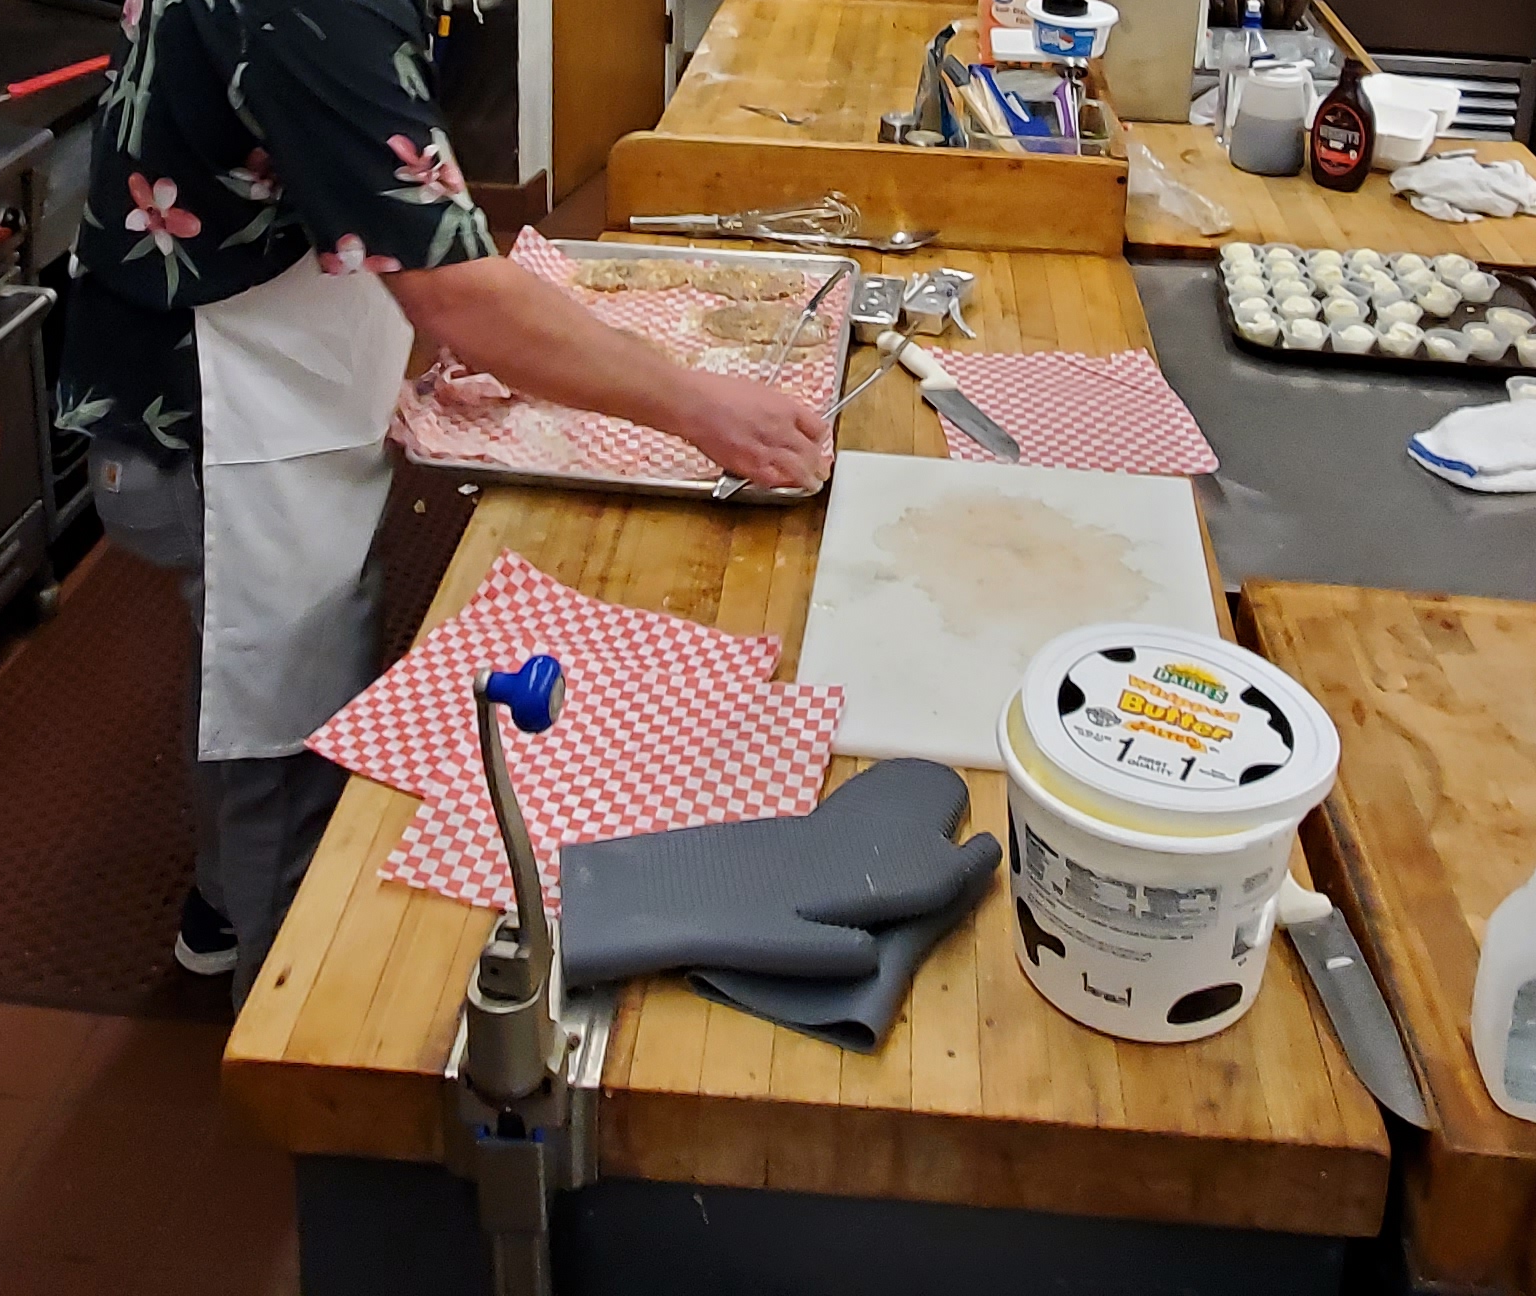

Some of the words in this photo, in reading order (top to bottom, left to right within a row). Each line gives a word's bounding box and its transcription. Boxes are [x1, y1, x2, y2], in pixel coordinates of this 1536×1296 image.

[1153, 667, 1228, 704] DAIRIES
[1117, 689, 1234, 742] Butter
[1116, 737, 1135, 763] 1
[1179, 756, 1196, 782] 1
